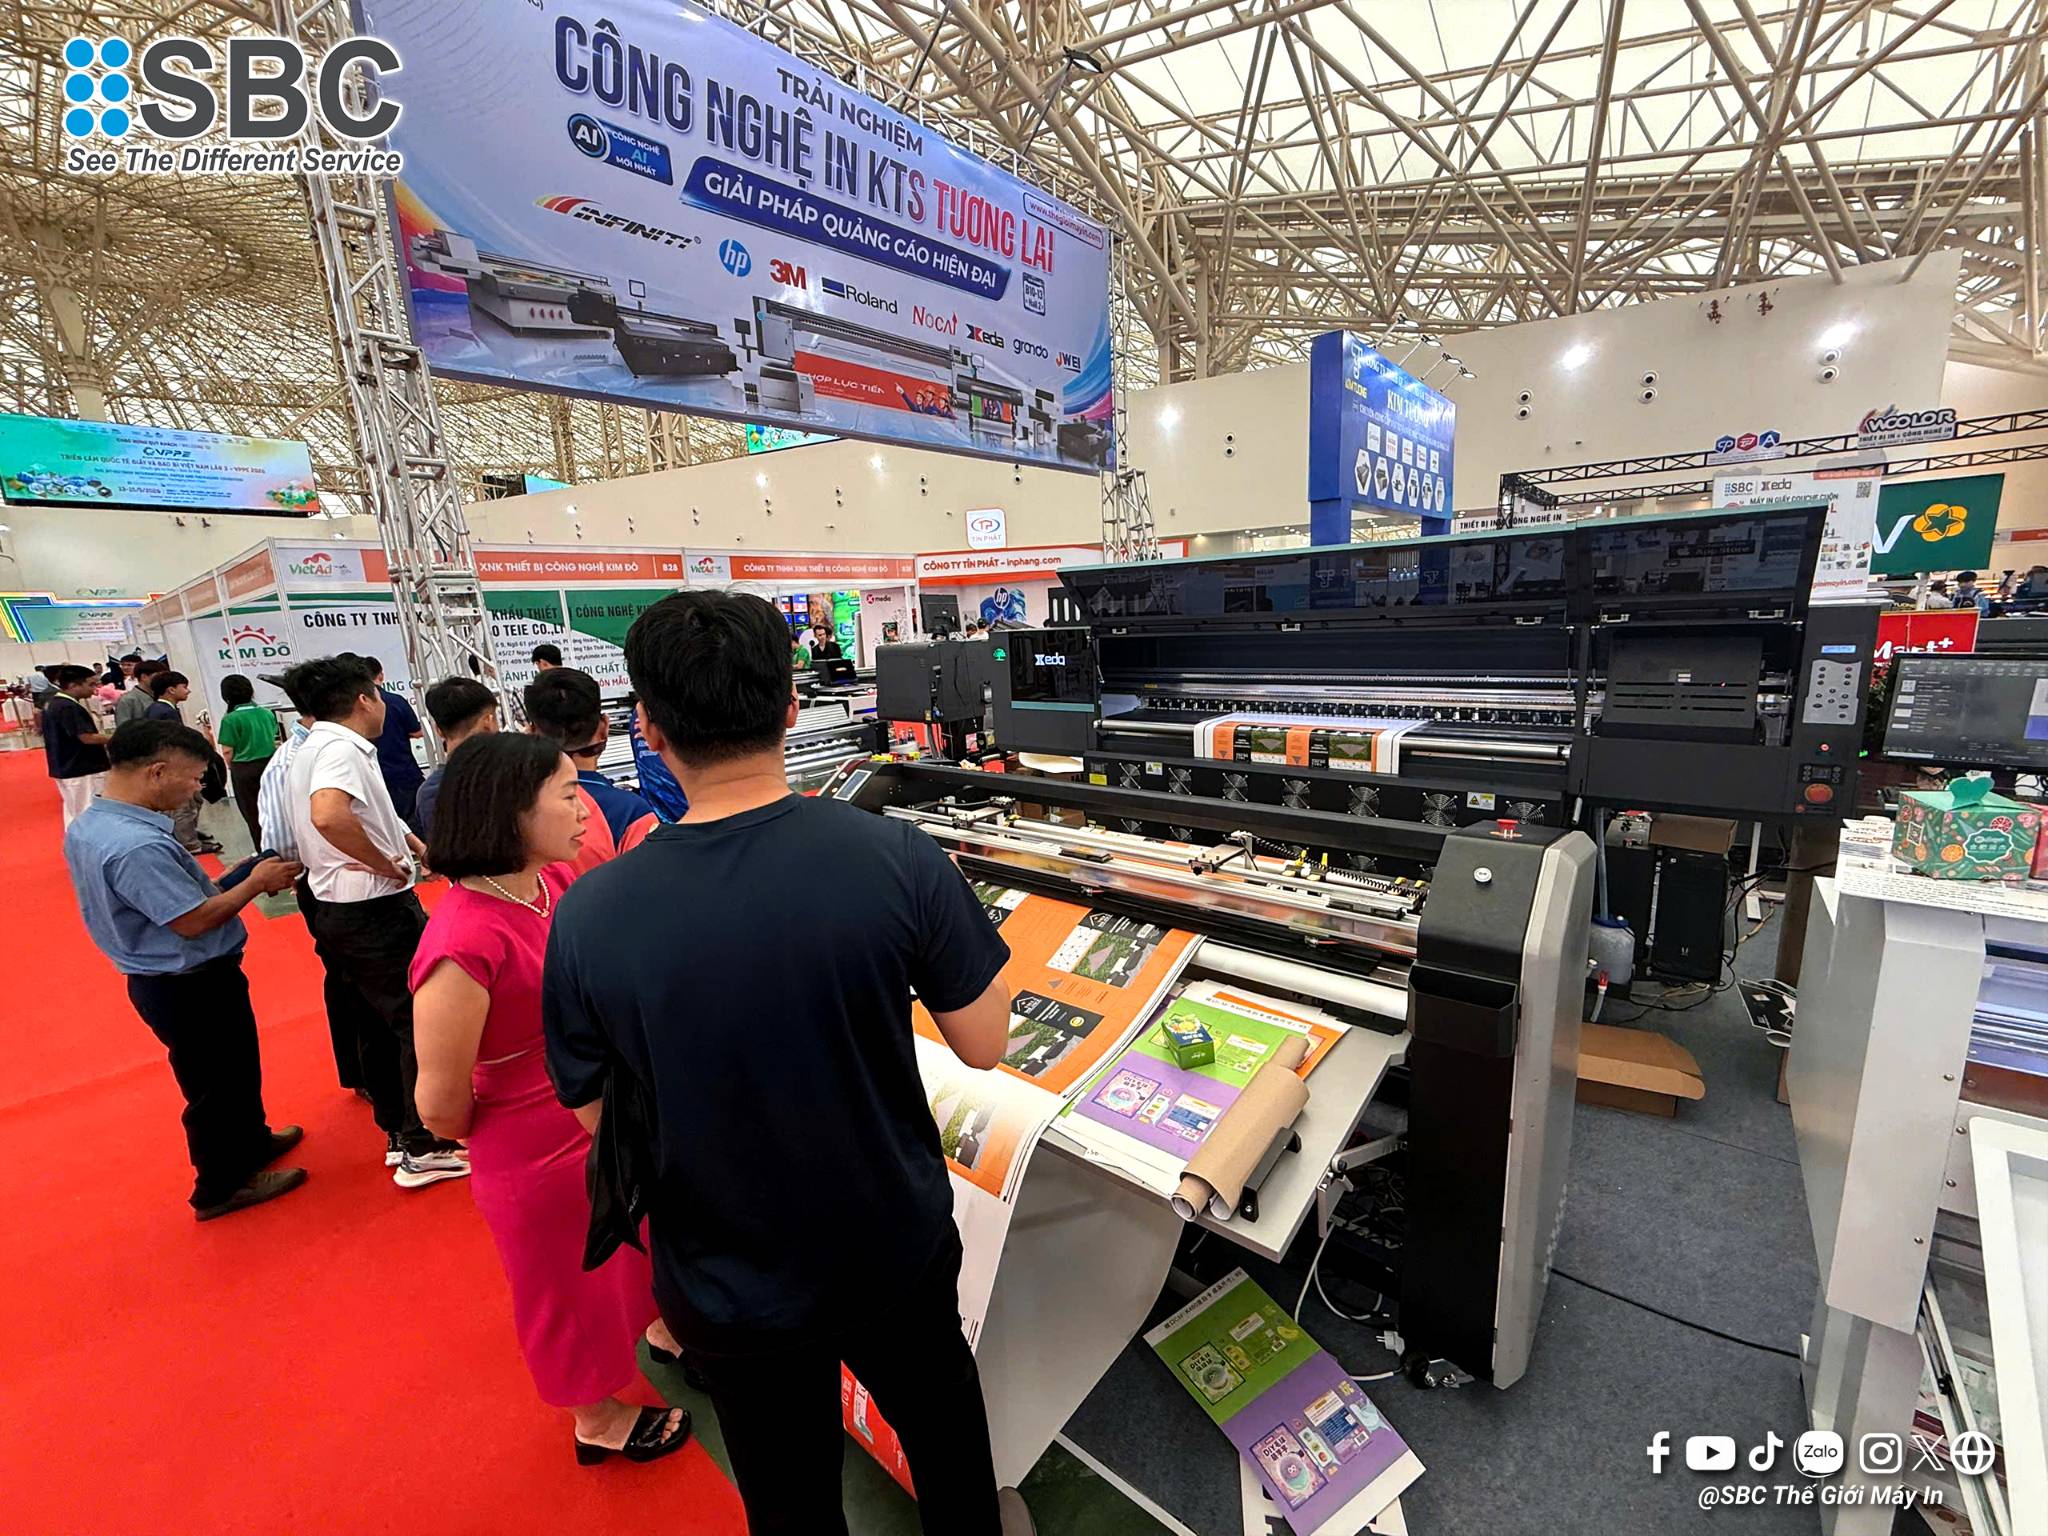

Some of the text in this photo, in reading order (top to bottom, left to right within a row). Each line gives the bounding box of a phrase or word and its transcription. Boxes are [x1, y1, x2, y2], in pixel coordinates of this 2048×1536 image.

[777, 67, 923, 156] TRẢI NGHIỆM
[554, 16, 1054, 273] CÔNG NGHỆ IN KTS TƯƠNG LAI
[576, 125, 598, 146] AI
[611, 130, 661, 156] CÔNG NGHỆ
[615, 155, 657, 176] MỚI NHẤT
[631, 149, 647, 163] AI
[704, 172, 996, 289] GIẢI PHÁP QUẢNG CÁO HIỆN ĐẠI
[723, 239, 748, 277] hp
[769, 258, 807, 290] 3M
[845, 284, 898, 315] Roland
[1460, 520, 1479, 529] THIẾT
[1553, 513, 1562, 521] IN
[479, 562, 503, 572] XNK
[504, 560, 532, 572] THIẾT
[533, 562, 544, 574] BỊ
[545, 560, 576, 572] CÔNG
[578, 561, 604, 574] NGHỆ
[606, 563, 623, 572] KIM
[624, 561, 638, 572] ĐÔ
[923, 555, 1062, 571] CÔNG TY TÍN PHÁT inphang.com
[303, 610, 347, 628] CÔNG
[349, 612, 367, 626] TY
[527, 604, 557, 619] THIẾT
[575, 604, 604, 618] CÔNG
[607, 602, 634, 618] NGHỆ
[503, 624, 529, 636] TEIE
[218, 648, 257, 659] KM
[595, 660, 620, 674] CHẤT
